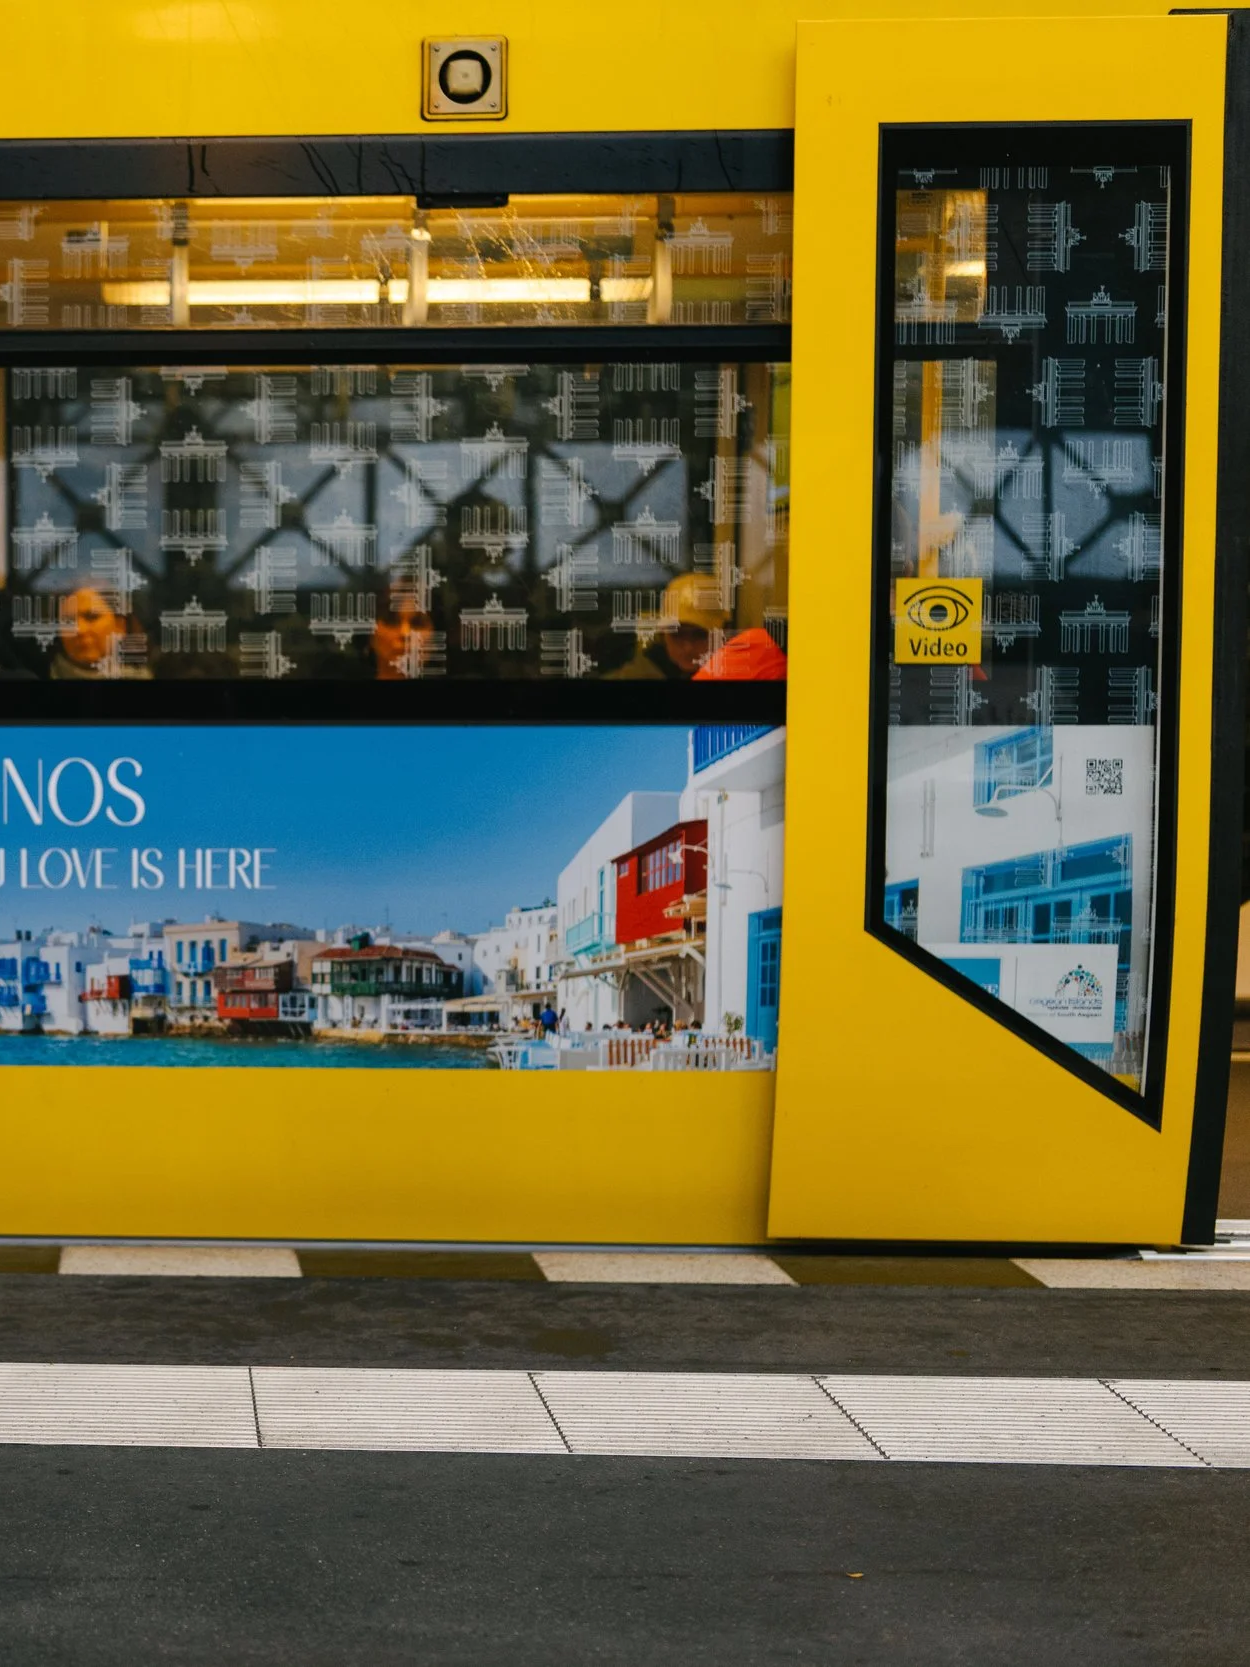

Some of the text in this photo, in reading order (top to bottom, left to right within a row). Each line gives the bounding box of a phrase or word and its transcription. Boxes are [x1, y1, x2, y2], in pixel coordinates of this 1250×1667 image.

[909, 637, 968, 657] Video
[20, 847, 119, 890] LOVE
[131, 847, 165, 890] IS
[177, 847, 277, 890] HERE
